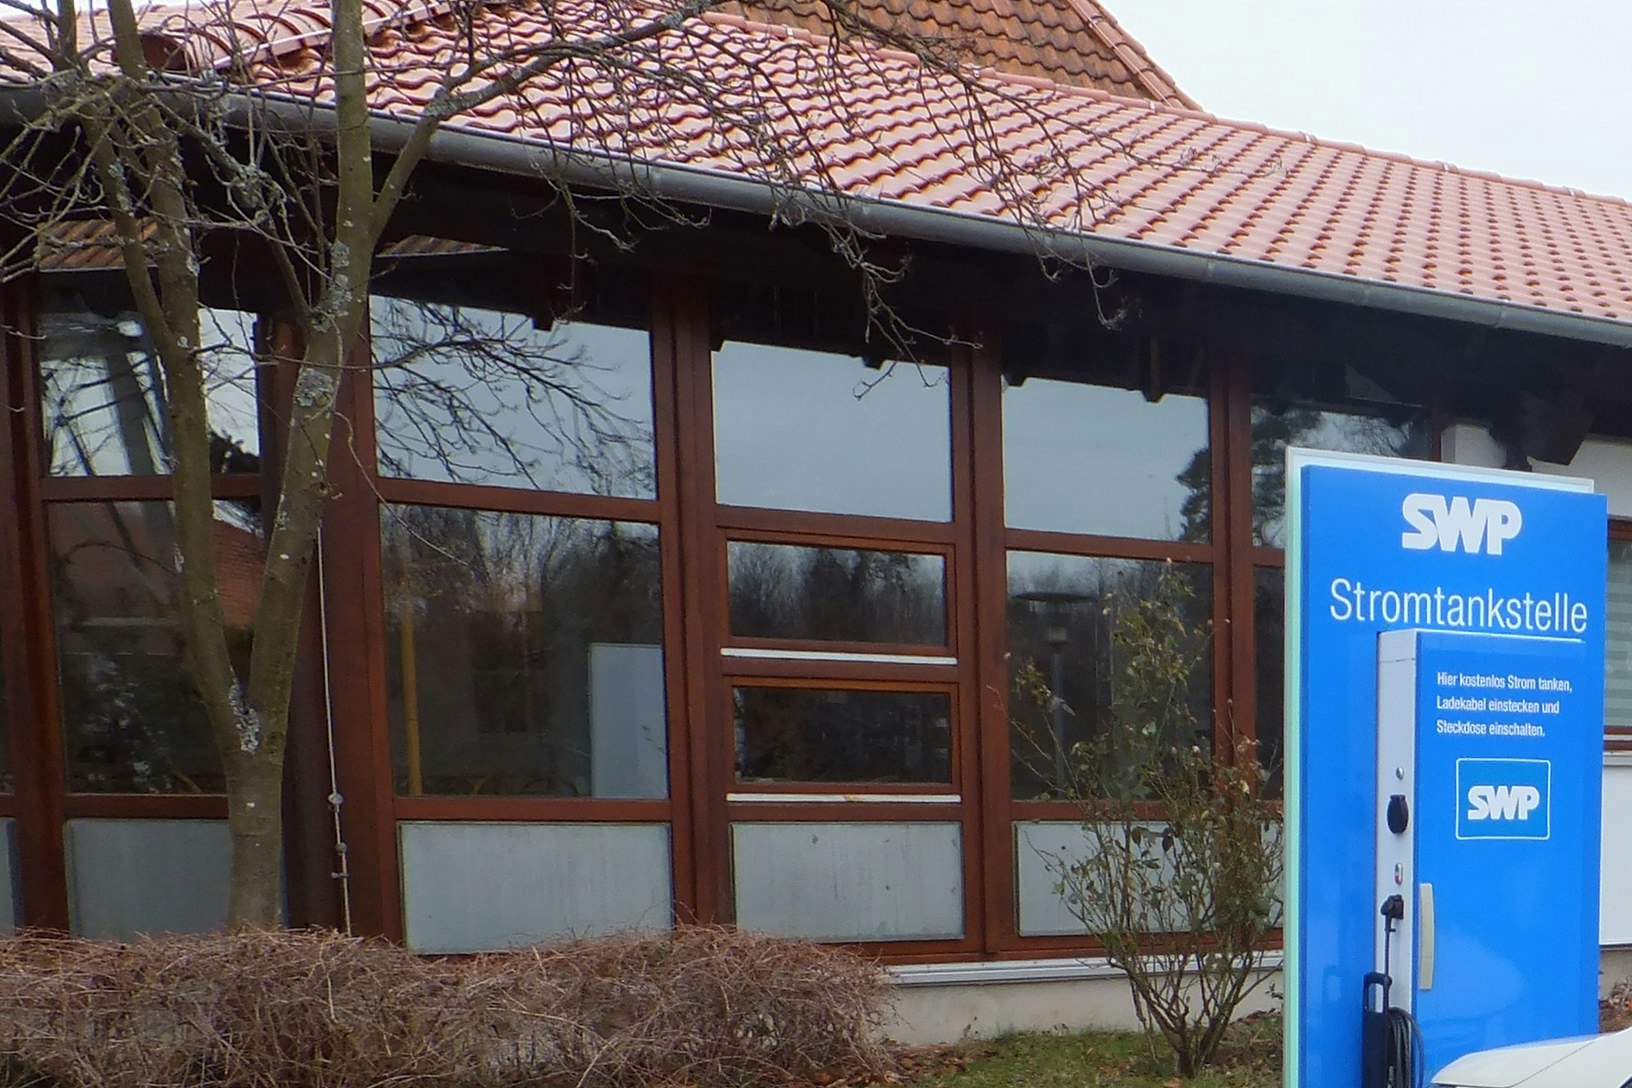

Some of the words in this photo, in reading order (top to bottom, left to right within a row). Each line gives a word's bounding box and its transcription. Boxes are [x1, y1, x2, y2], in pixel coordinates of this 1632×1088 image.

[1402, 493, 1522, 555] SWP
[1330, 577, 1588, 633] Stromtankstelle
[1437, 672, 1457, 686] Hier
[1459, 673, 1505, 688] kostenlos
[1507, 675, 1536, 690] Strom
[1436, 695, 1486, 710] Ladekabel
[1488, 699, 1540, 713] einstecken
[1541, 701, 1560, 713] und
[1436, 720, 1487, 734] Steckdose
[1489, 722, 1545, 736] einschalten.
[1467, 785, 1540, 821] SWP
